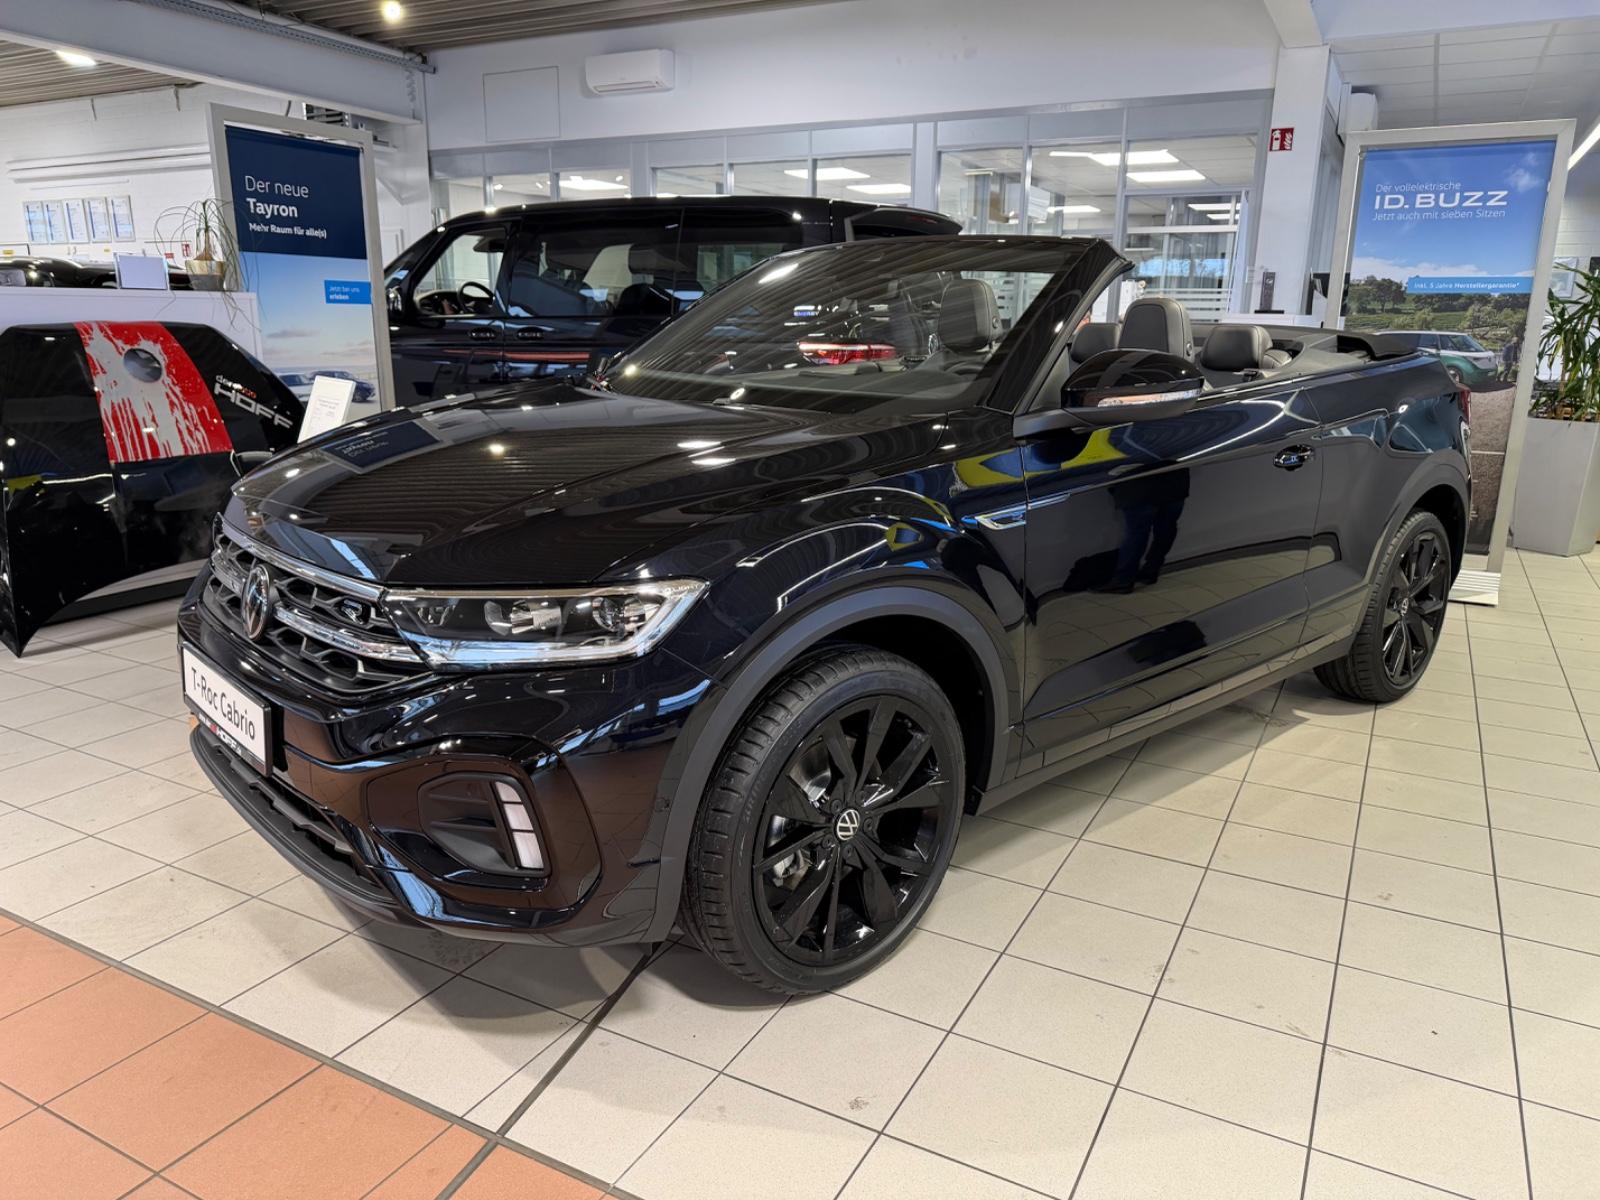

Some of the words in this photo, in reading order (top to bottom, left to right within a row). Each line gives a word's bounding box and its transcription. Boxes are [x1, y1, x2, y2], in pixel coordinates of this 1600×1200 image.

[244, 175, 271, 193] Der
[274, 182, 309, 198] neue
[1376, 184, 1391, 193] Der
[1394, 182, 1461, 192] vollelektrische
[246, 198, 298, 219] Tayron
[1415, 190, 1509, 209] BUZZ
[1372, 211, 1395, 221] Jetzt
[1397, 211, 1421, 220] auch
[1423, 210, 1439, 220] mit
[1441, 209, 1473, 219] sieben
[1476, 209, 1506, 218] Sitzen
[248, 222, 270, 233] Mehr
[270, 225, 293, 235] Raum
[294, 226, 304, 236] für
[305, 228, 327, 239] alle(s)
[214, 382, 293, 429] HOFF
[191, 666, 218, 711] T-Roc
[220, 692, 255, 741] Cabrio
